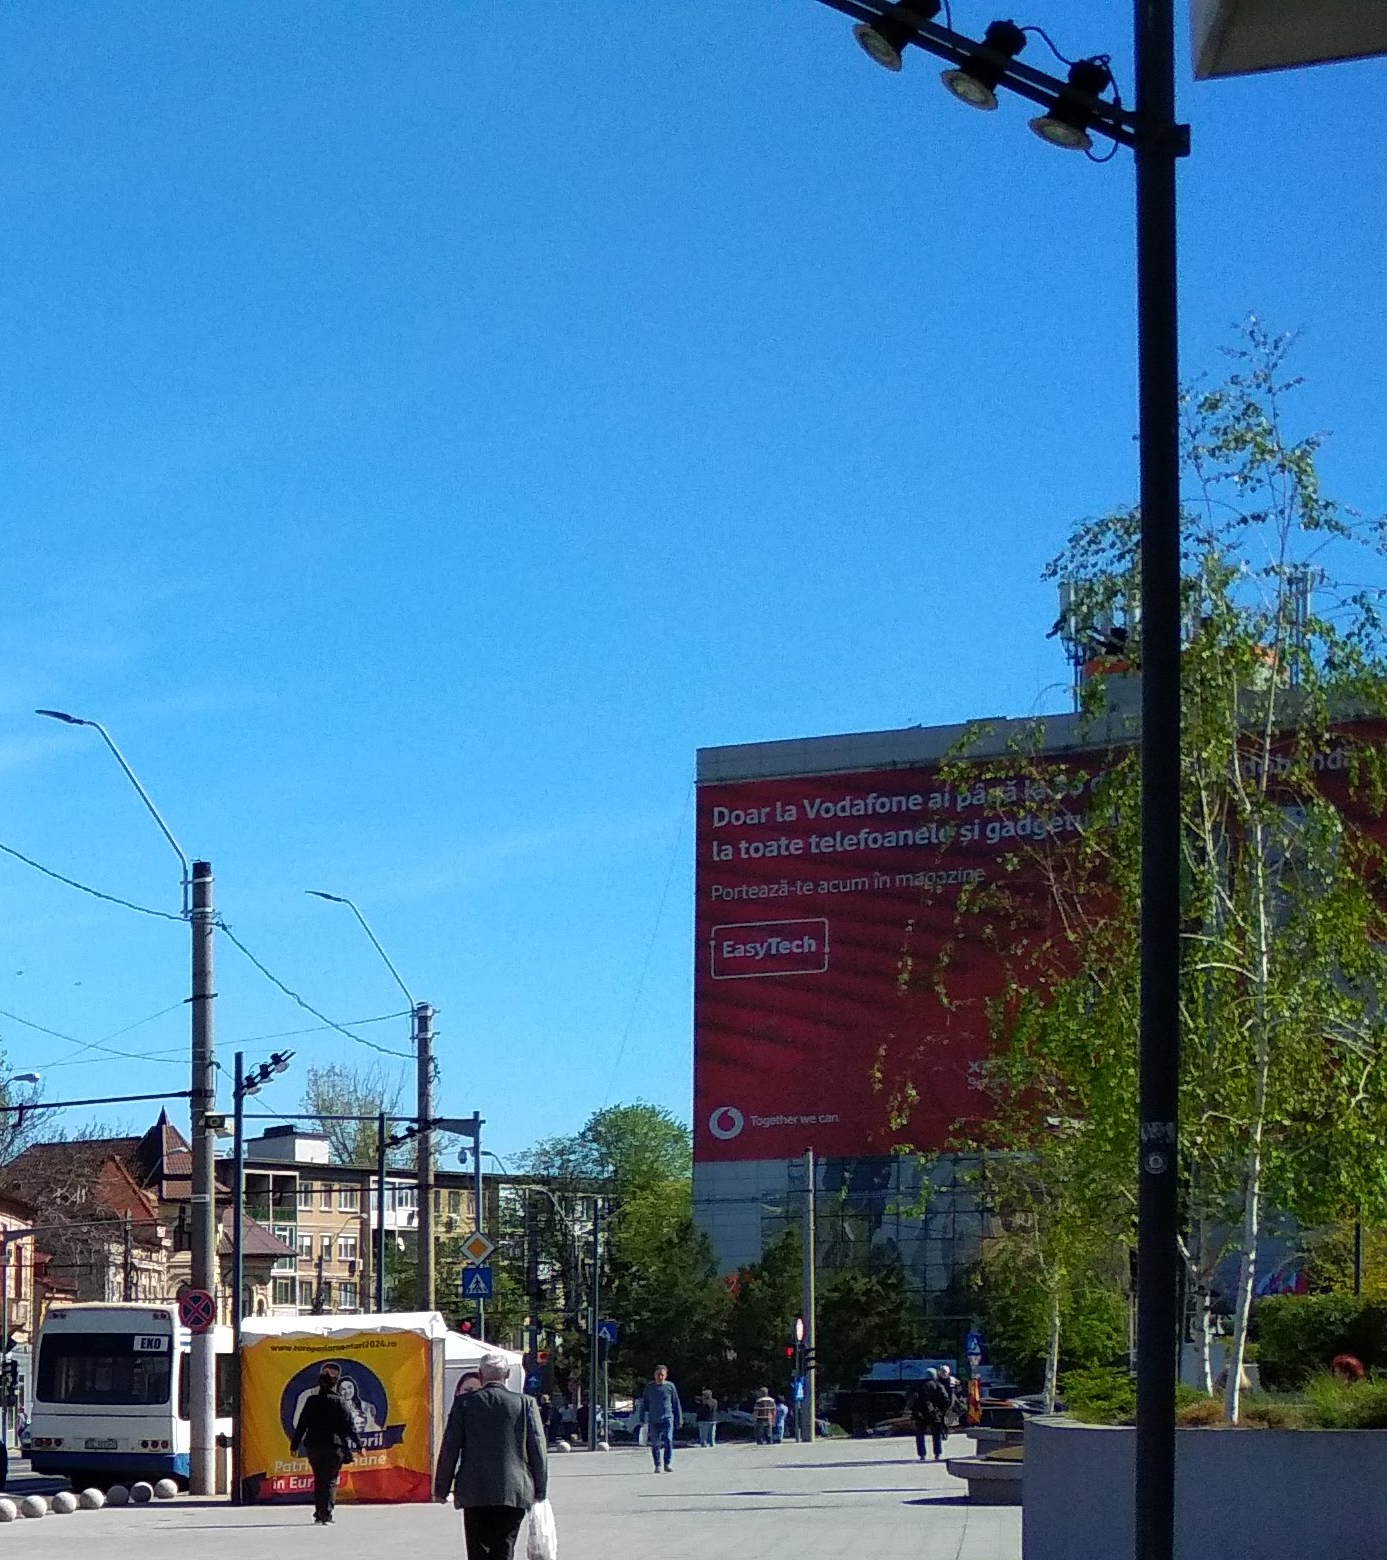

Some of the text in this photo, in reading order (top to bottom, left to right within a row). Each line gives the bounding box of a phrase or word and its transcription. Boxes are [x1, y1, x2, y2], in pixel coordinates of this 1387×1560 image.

[712, 804, 770, 828] Doar
[776, 801, 797, 822] la
[802, 793, 923, 819] Vodafone
[928, 788, 950, 811] ai
[956, 780, 1017, 812] pâă
[712, 840, 733, 861] la
[739, 837, 804, 859] toate
[810, 822, 955, 854] telefoanele
[959, 820, 980, 847] și
[712, 867, 986, 901] Portează-te acum în magazine
[722, 936, 817, 960] EasyTech
[750, 1114, 839, 1128] Together we can
[140, 1337, 161, 1350] EKO
[273, 1476, 285, 1490] în
